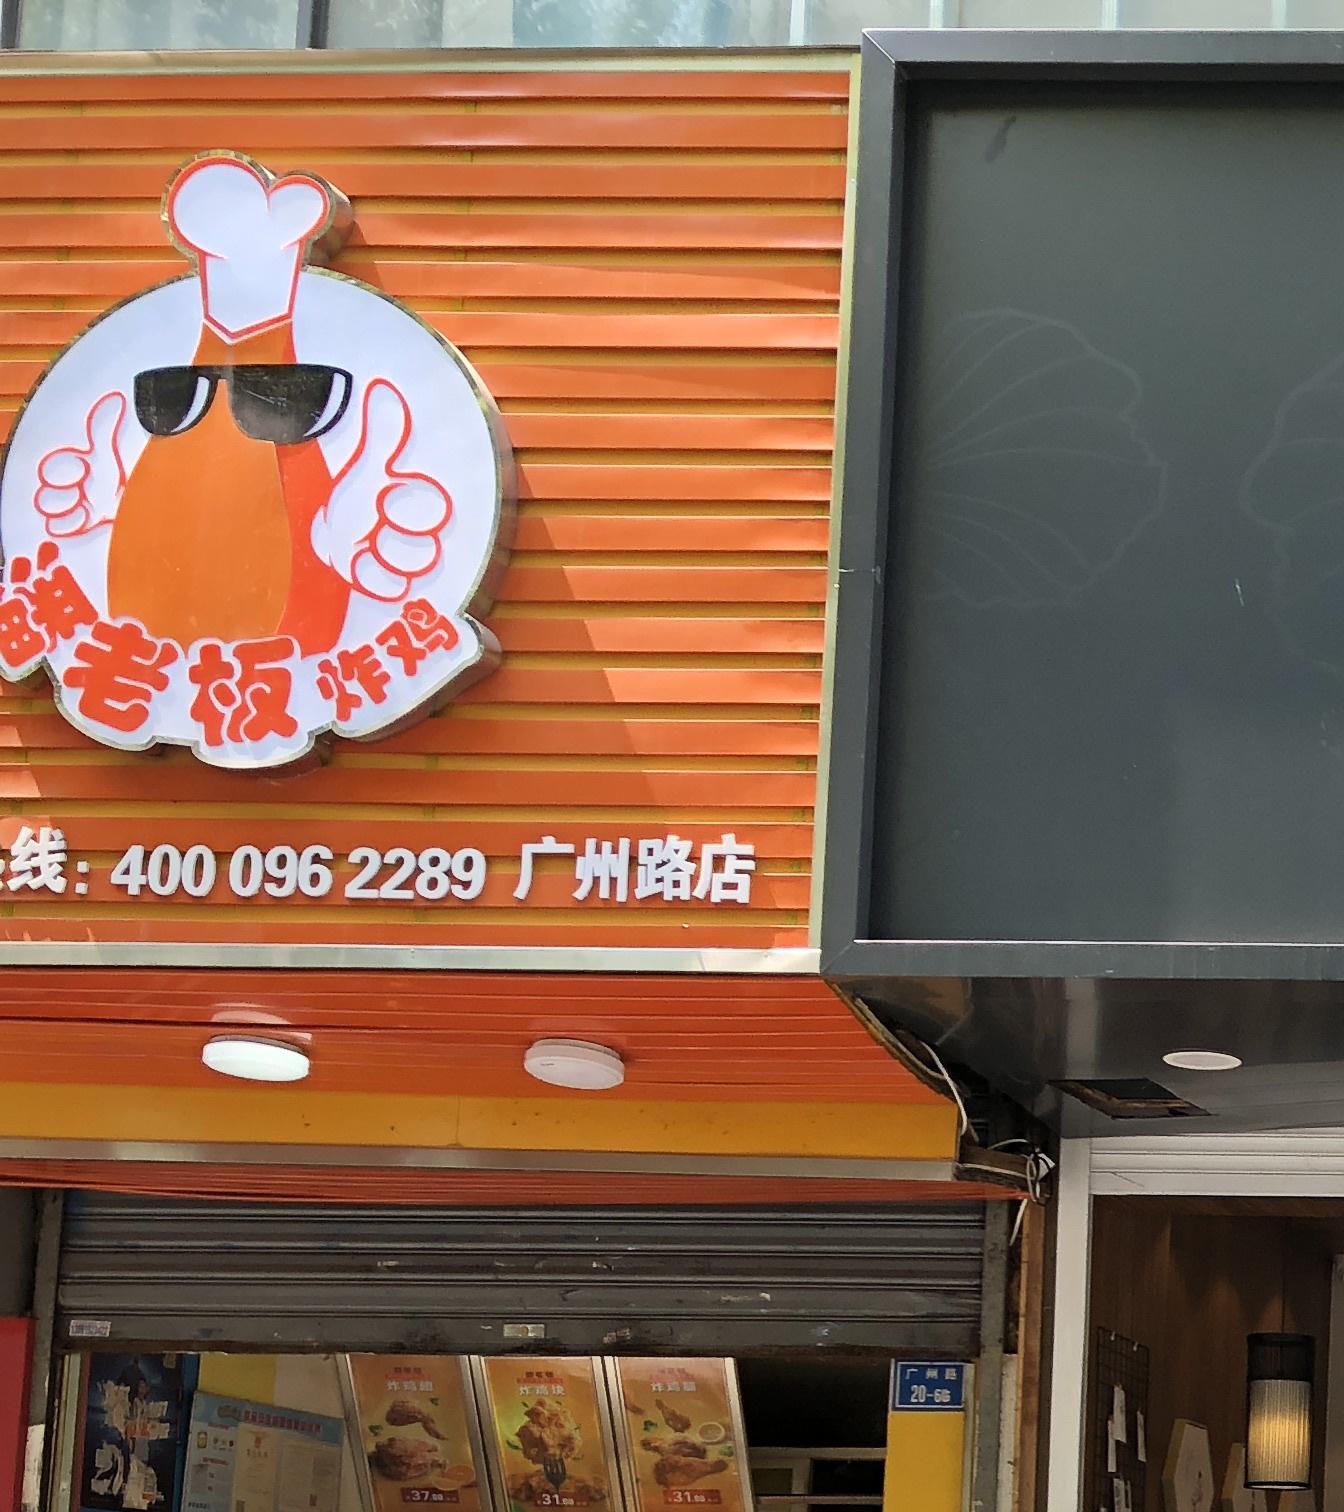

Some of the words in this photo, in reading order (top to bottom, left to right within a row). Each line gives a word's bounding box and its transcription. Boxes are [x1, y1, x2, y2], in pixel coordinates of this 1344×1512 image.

[0, 825, 90, 896] 线:
[110, 843, 217, 898] 400
[228, 844, 334, 899] 096
[344, 847, 487, 901] 2289
[512, 833, 757, 904] 广州路店
